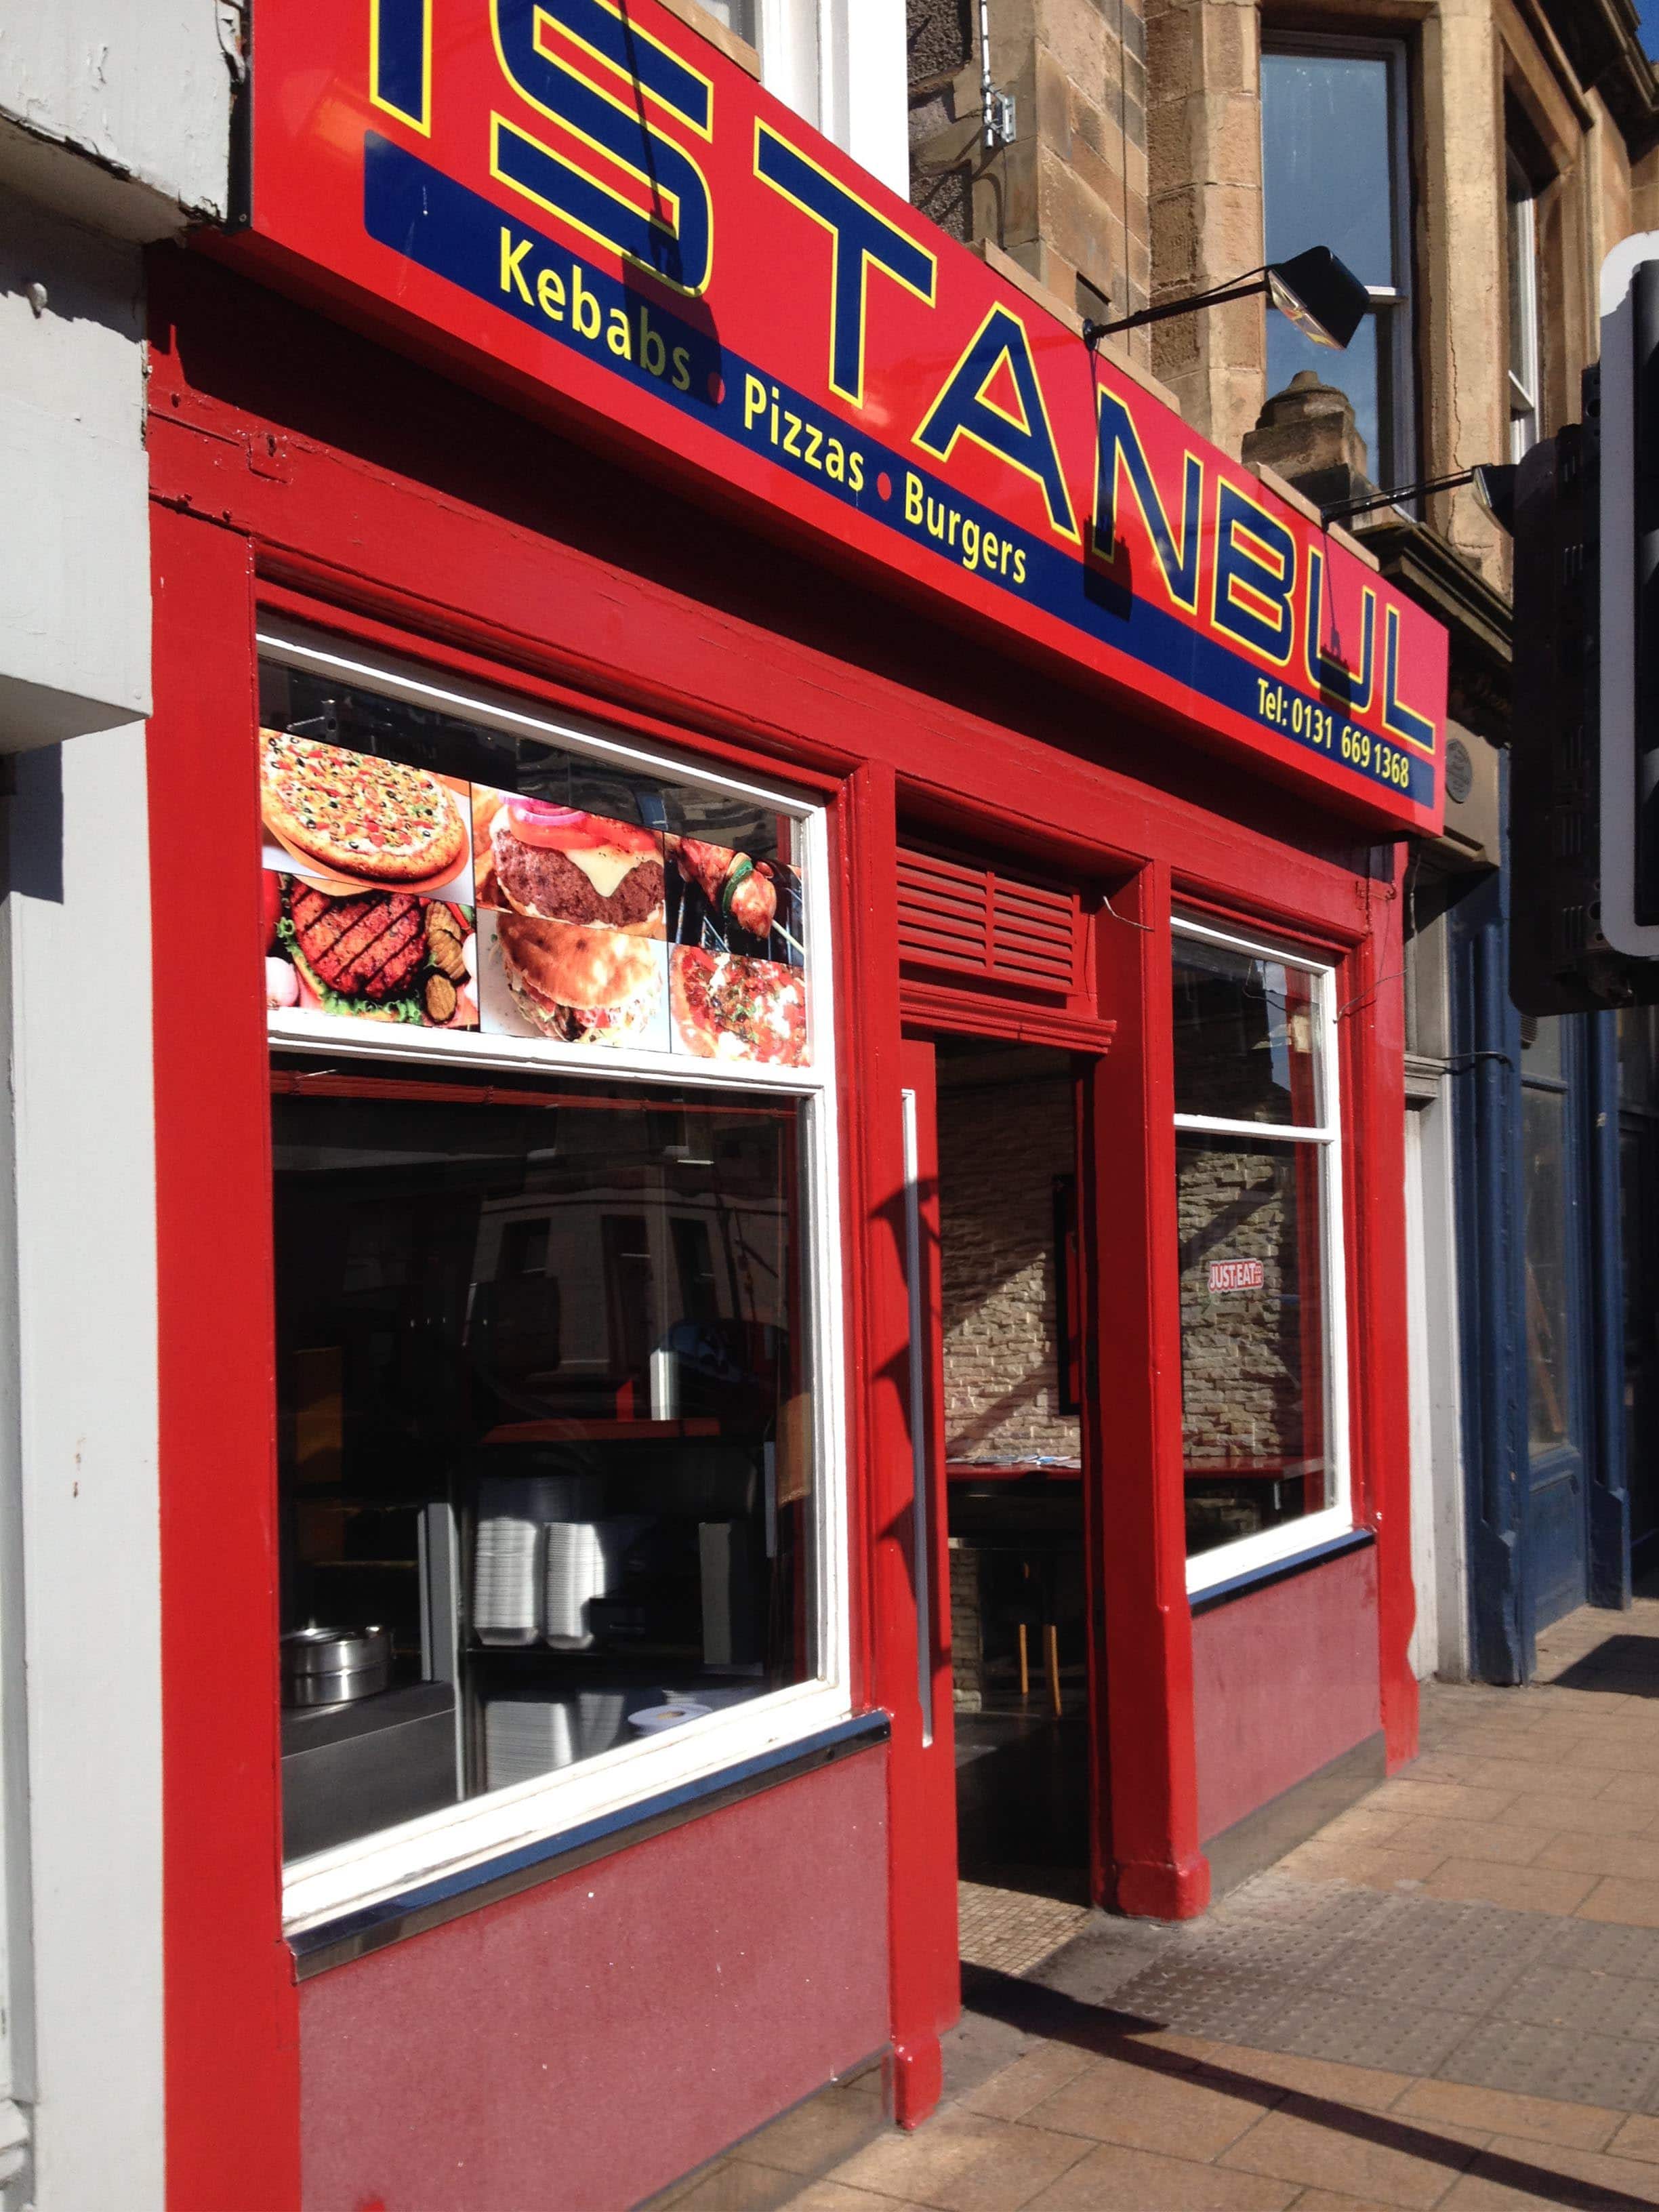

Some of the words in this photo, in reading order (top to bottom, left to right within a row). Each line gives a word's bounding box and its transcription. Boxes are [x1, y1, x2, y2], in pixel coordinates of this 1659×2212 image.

[500, 226, 691, 390] Kebabs
[744, 373, 864, 492] Pizzas
[905, 470, 1026, 584] Burgers
[1258, 678, 1288, 726] Tel:
[1292, 697, 1332, 749] 0131
[1340, 725, 1372, 769] 669
[1374, 743, 1410, 788] 1368
[1210, 1264, 1235, 1288] JUST
[1237, 1262, 1256, 1286] EAT
